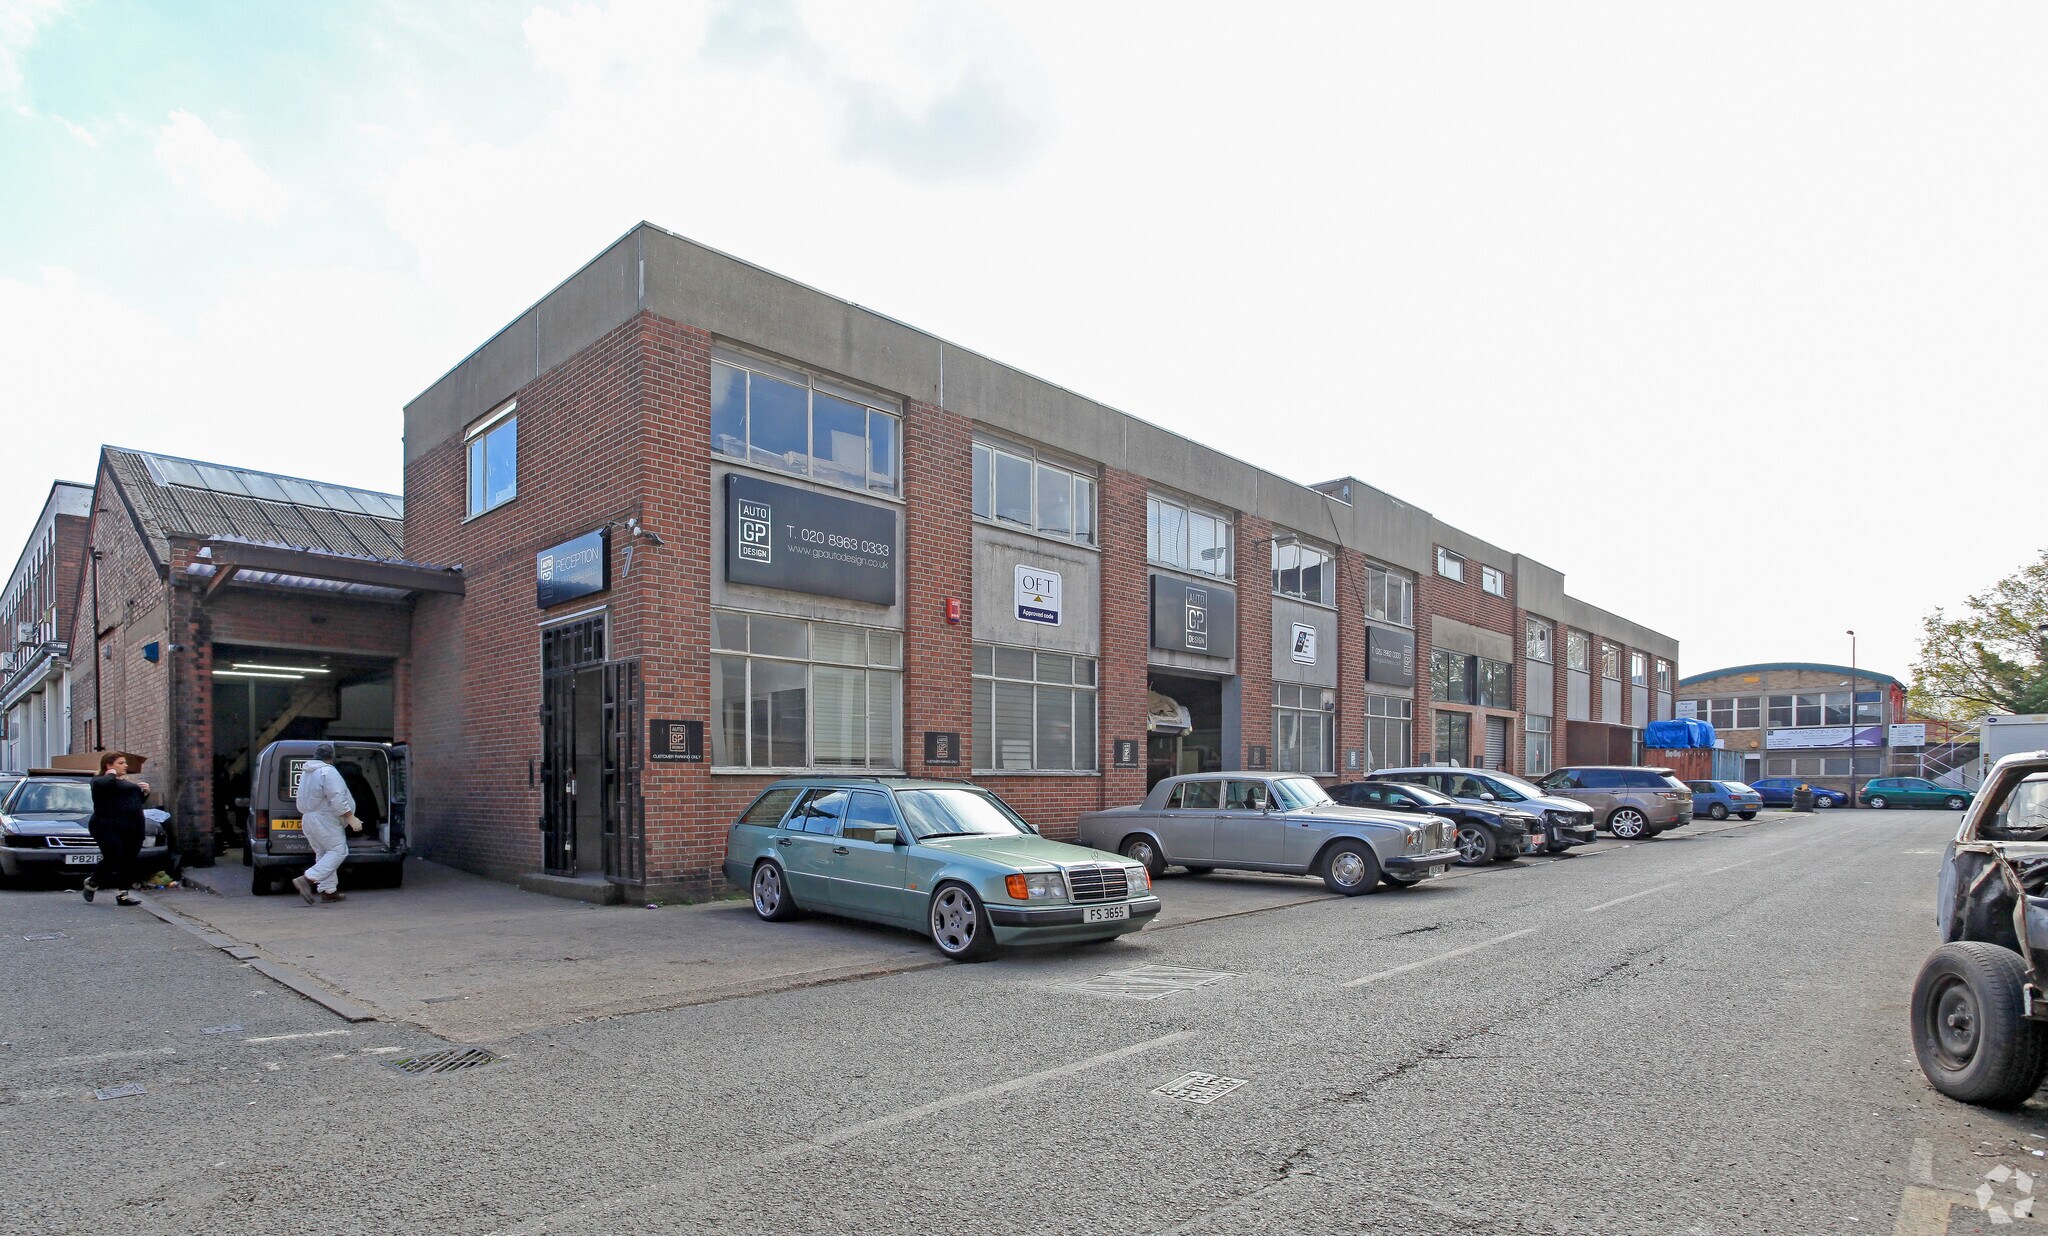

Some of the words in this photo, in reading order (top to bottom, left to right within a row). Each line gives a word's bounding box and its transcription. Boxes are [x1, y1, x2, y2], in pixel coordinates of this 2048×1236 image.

[743, 505, 767, 519] AUTO
[743, 521, 766, 543] GP
[786, 525, 797, 539] T.
[801, 528, 825, 544] 020
[828, 534, 858, 550] 8963
[861, 540, 890, 557] 0333
[555, 546, 599, 573] RECEPTION
[743, 547, 767, 558] DESIGN
[787, 544, 889, 570] www.gpautodesign.co.uk
[621, 545, 634, 578] 7
[1022, 575, 1054, 593] OFT
[1189, 593, 1205, 605] AUTO
[1022, 609, 1044, 618] Approved
[1189, 609, 1204, 630] GP
[1189, 635, 1205, 645] DESIGN
[671, 734, 684, 743] GP
[280, 821, 294, 829] A17
[1090, 908, 1102, 920] FS
